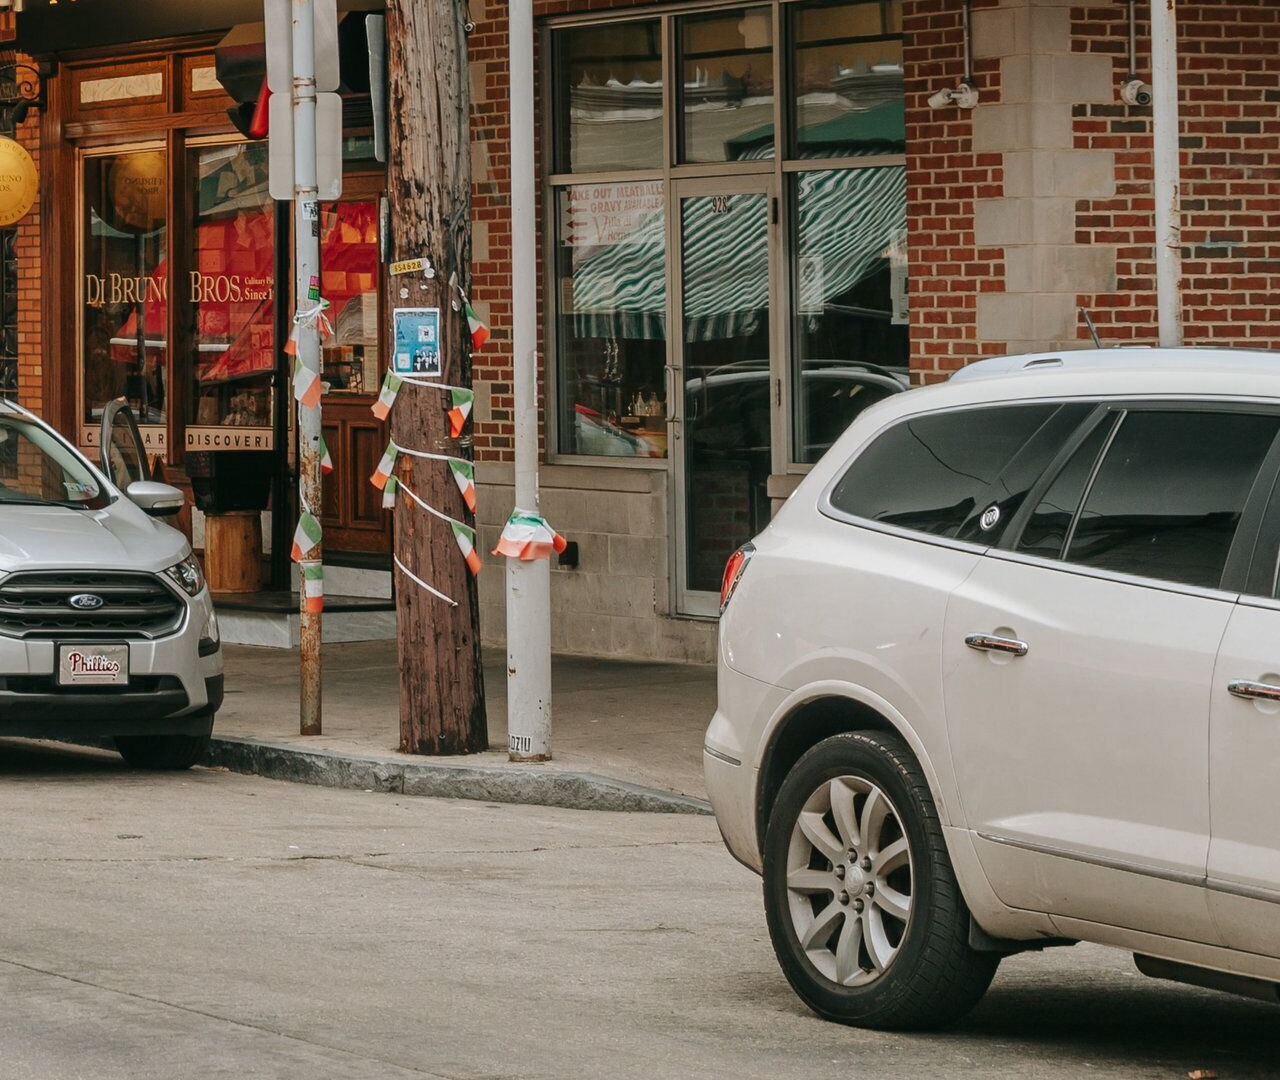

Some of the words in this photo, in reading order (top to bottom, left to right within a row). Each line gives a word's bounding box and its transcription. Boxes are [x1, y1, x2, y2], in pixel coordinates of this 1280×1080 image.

[567, 190, 589, 202] TAKE
[593, 188, 611, 200] OUT
[591, 200, 622, 214] GRAVY
[711, 197, 728, 214] 928
[110, 273, 168, 304] BRUN
[244, 288, 267, 301] Since
[78, 596, 97, 606] Ford
[68, 652, 120, 672] Phillies
